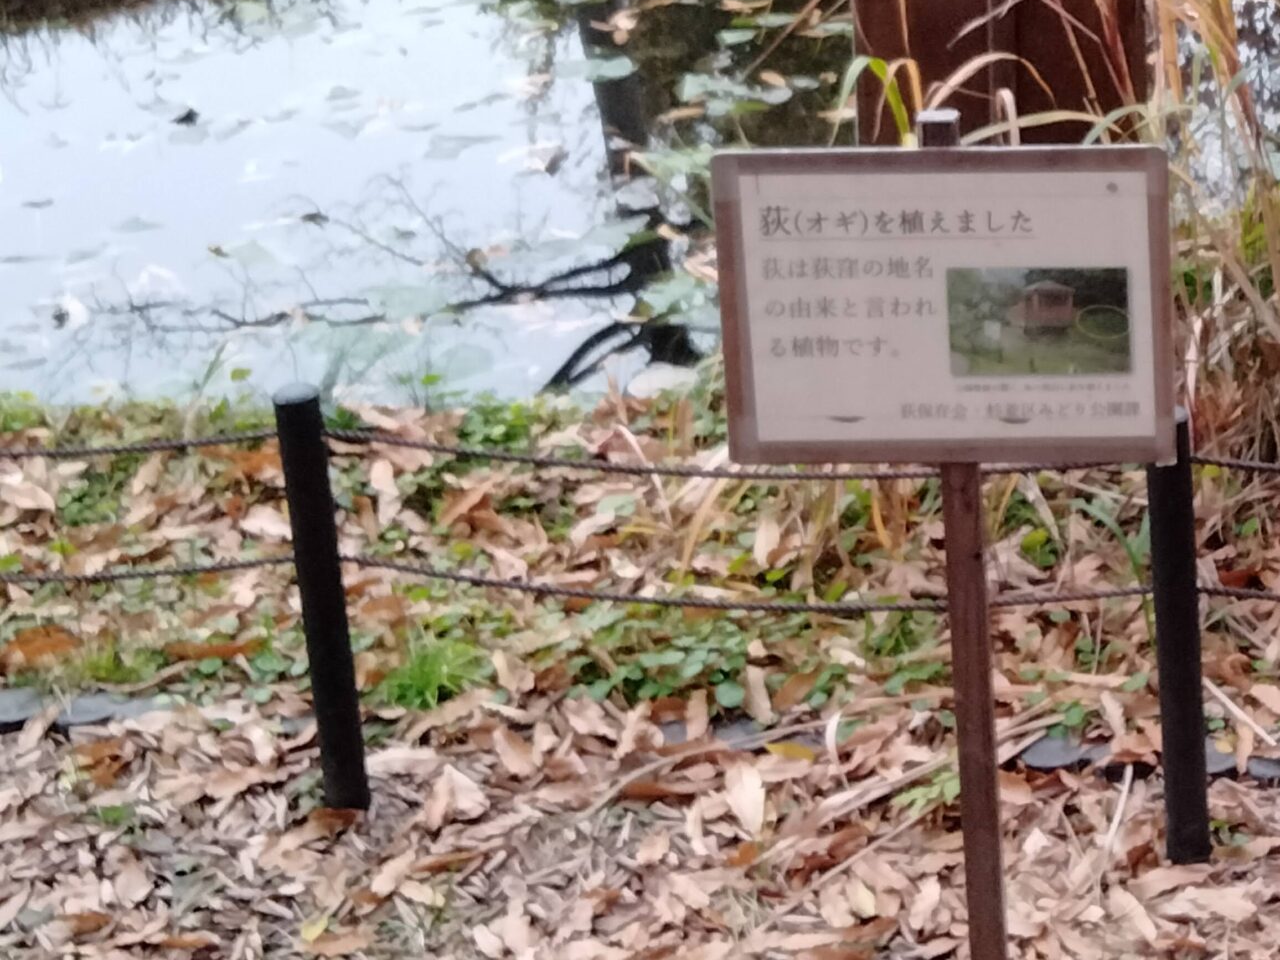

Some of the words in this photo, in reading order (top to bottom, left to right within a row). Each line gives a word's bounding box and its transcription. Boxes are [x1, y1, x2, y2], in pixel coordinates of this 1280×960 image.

[759, 205, 1034, 237] 荻(オギ)を植えました
[761, 256, 934, 280] 荻は荻窪の地名
[764, 296, 937, 319] の由来と言われ
[769, 335, 901, 358] る植物です。
